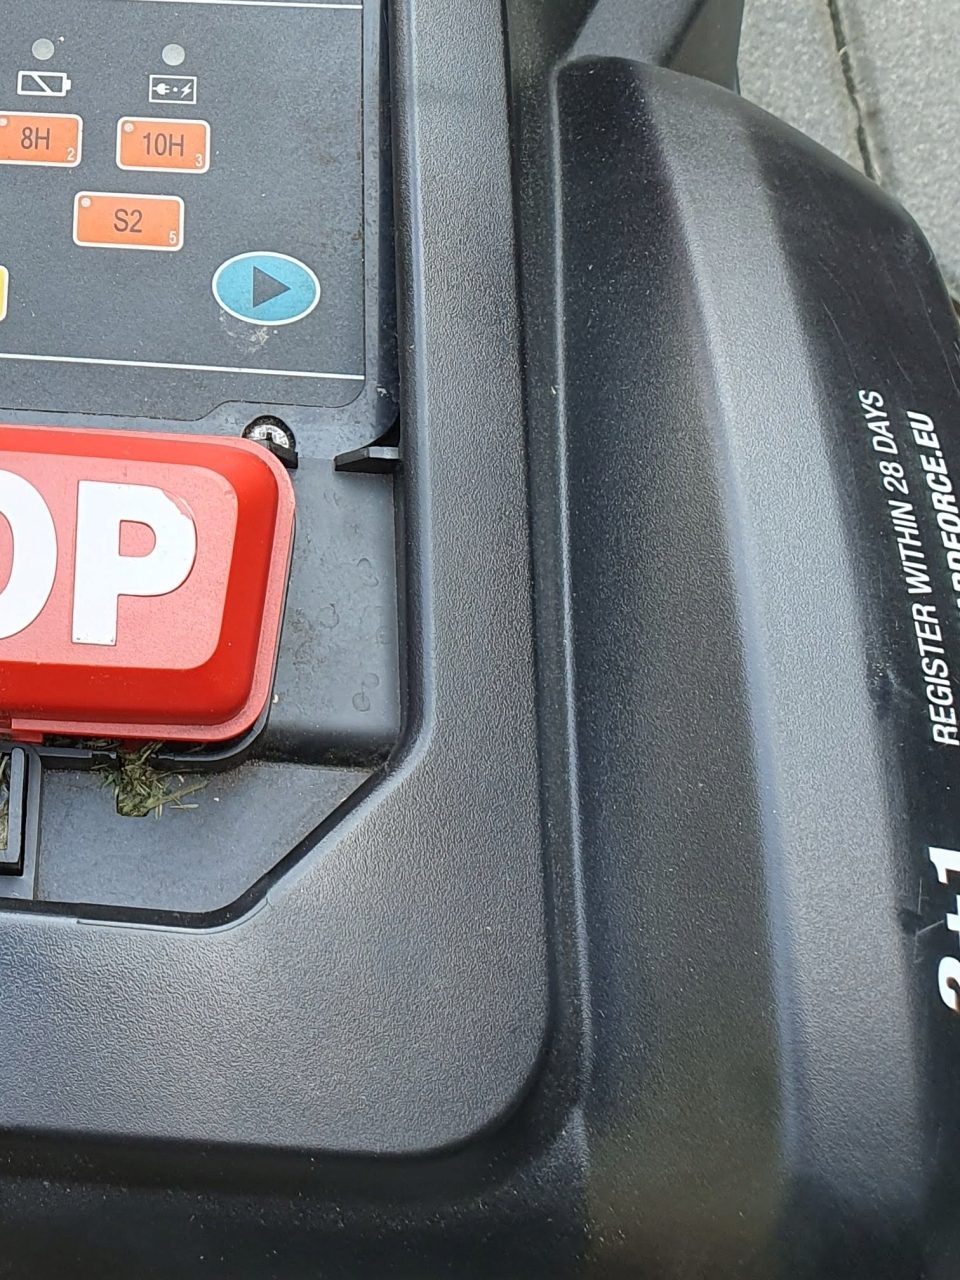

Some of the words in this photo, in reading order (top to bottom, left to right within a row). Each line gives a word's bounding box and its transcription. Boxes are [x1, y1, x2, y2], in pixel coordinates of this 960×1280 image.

[20, 126, 51, 151] 8H
[142, 132, 185, 157] 10H
[66, 148, 75, 161] 2
[195, 153, 203, 167] 3
[113, 208, 144, 233] S2
[169, 230, 177, 244] 5
[858, 389, 898, 455] DAYS
[879, 460, 909, 495] 28
[887, 500, 933, 594] WITHIN
[911, 603, 960, 747] REGISTER
